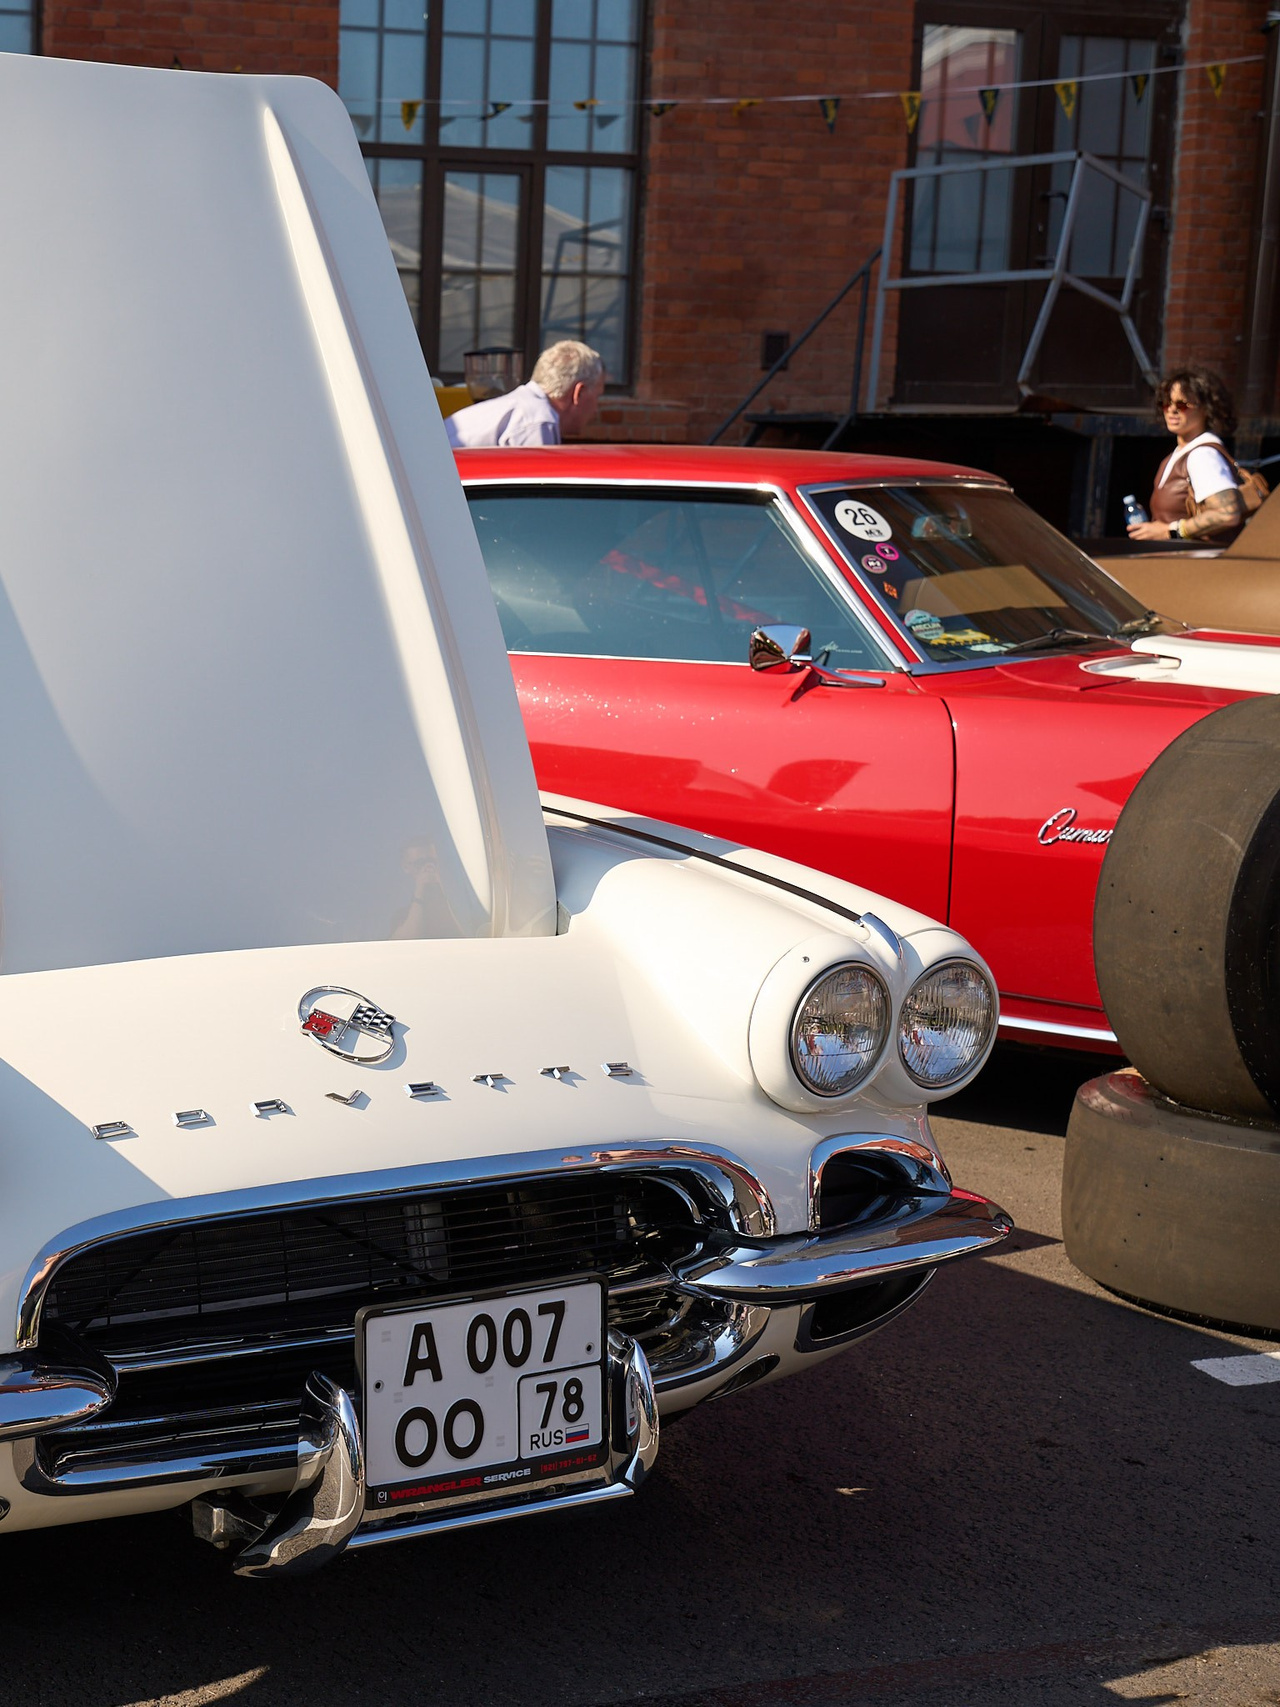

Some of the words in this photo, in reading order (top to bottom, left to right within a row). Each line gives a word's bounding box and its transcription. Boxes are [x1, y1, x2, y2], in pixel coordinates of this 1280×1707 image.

[844, 508, 877, 526] 26
[403, 1322, 443, 1387] A
[466, 1300, 566, 1374] 007
[536, 1377, 584, 1429] 78
[530, 1429, 563, 1450] RUS
[390, 1476, 484, 1500] WRANGLER
[483, 1467, 532, 1484] SERVICE
